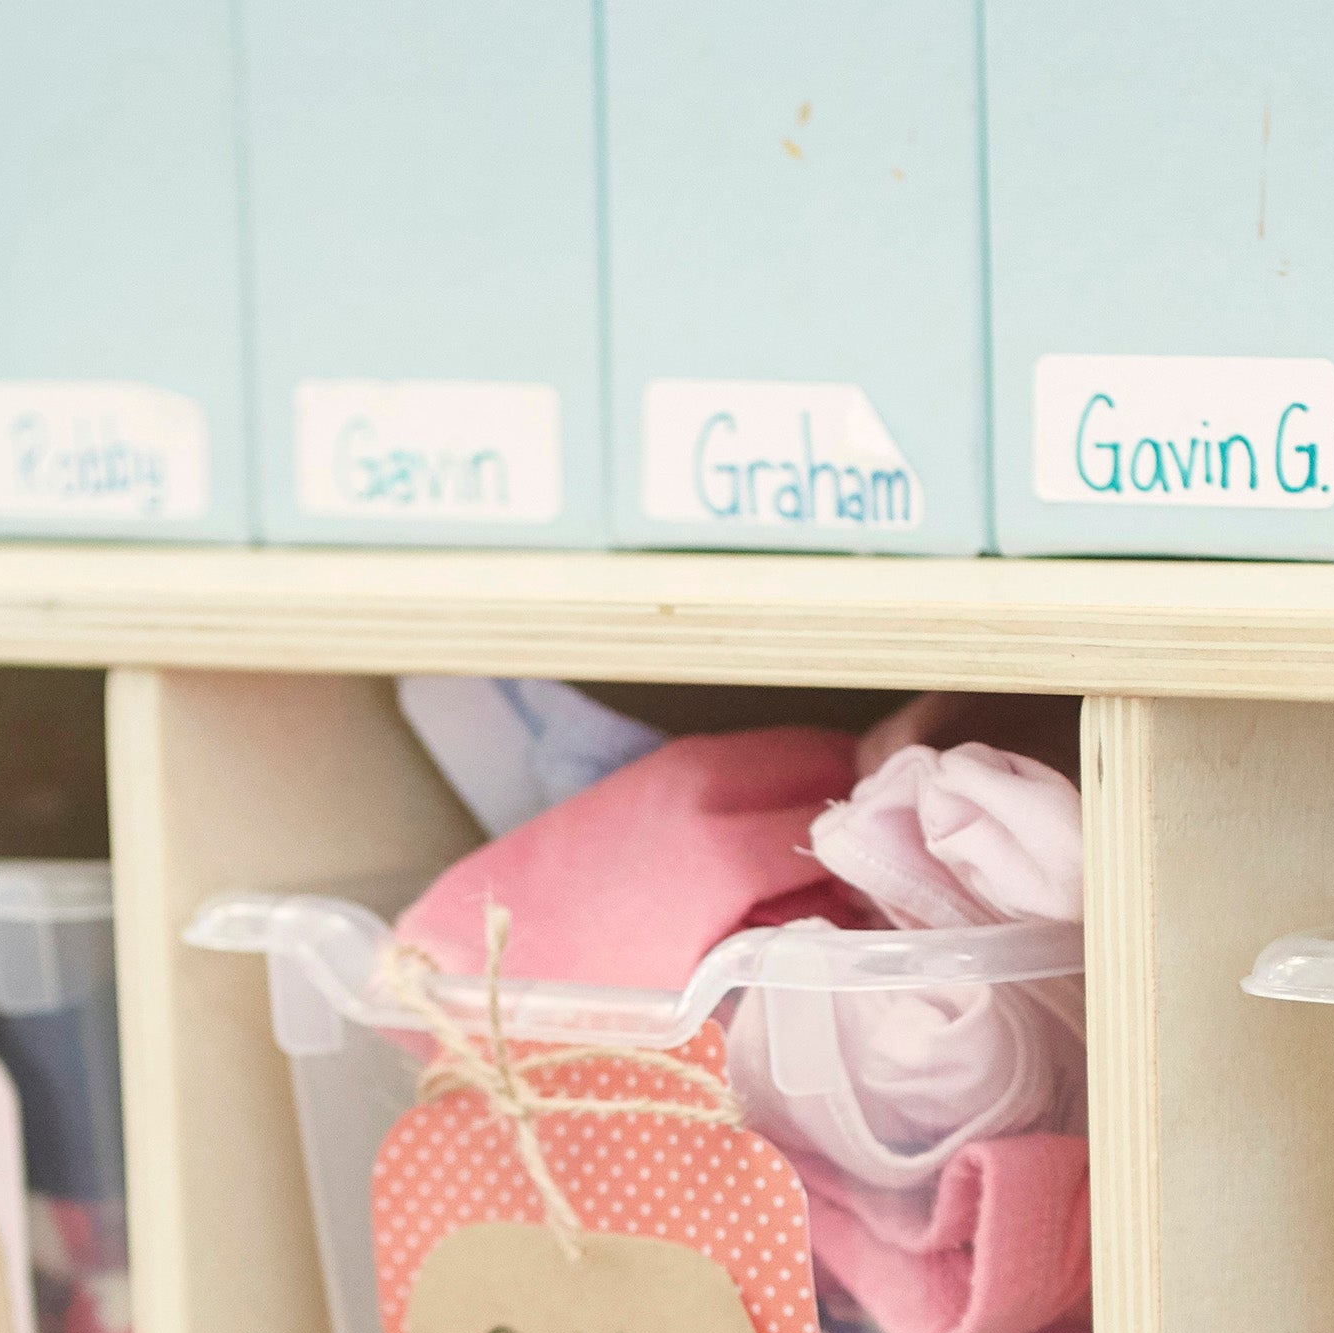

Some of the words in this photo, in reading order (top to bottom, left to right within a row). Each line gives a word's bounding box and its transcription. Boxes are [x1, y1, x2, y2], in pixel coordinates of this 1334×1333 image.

[332, 417, 510, 503] Gavin
[692, 411, 912, 523] Graham
[1076, 393, 1258, 494] Gavin
[1275, 402, 1331, 494] G.
